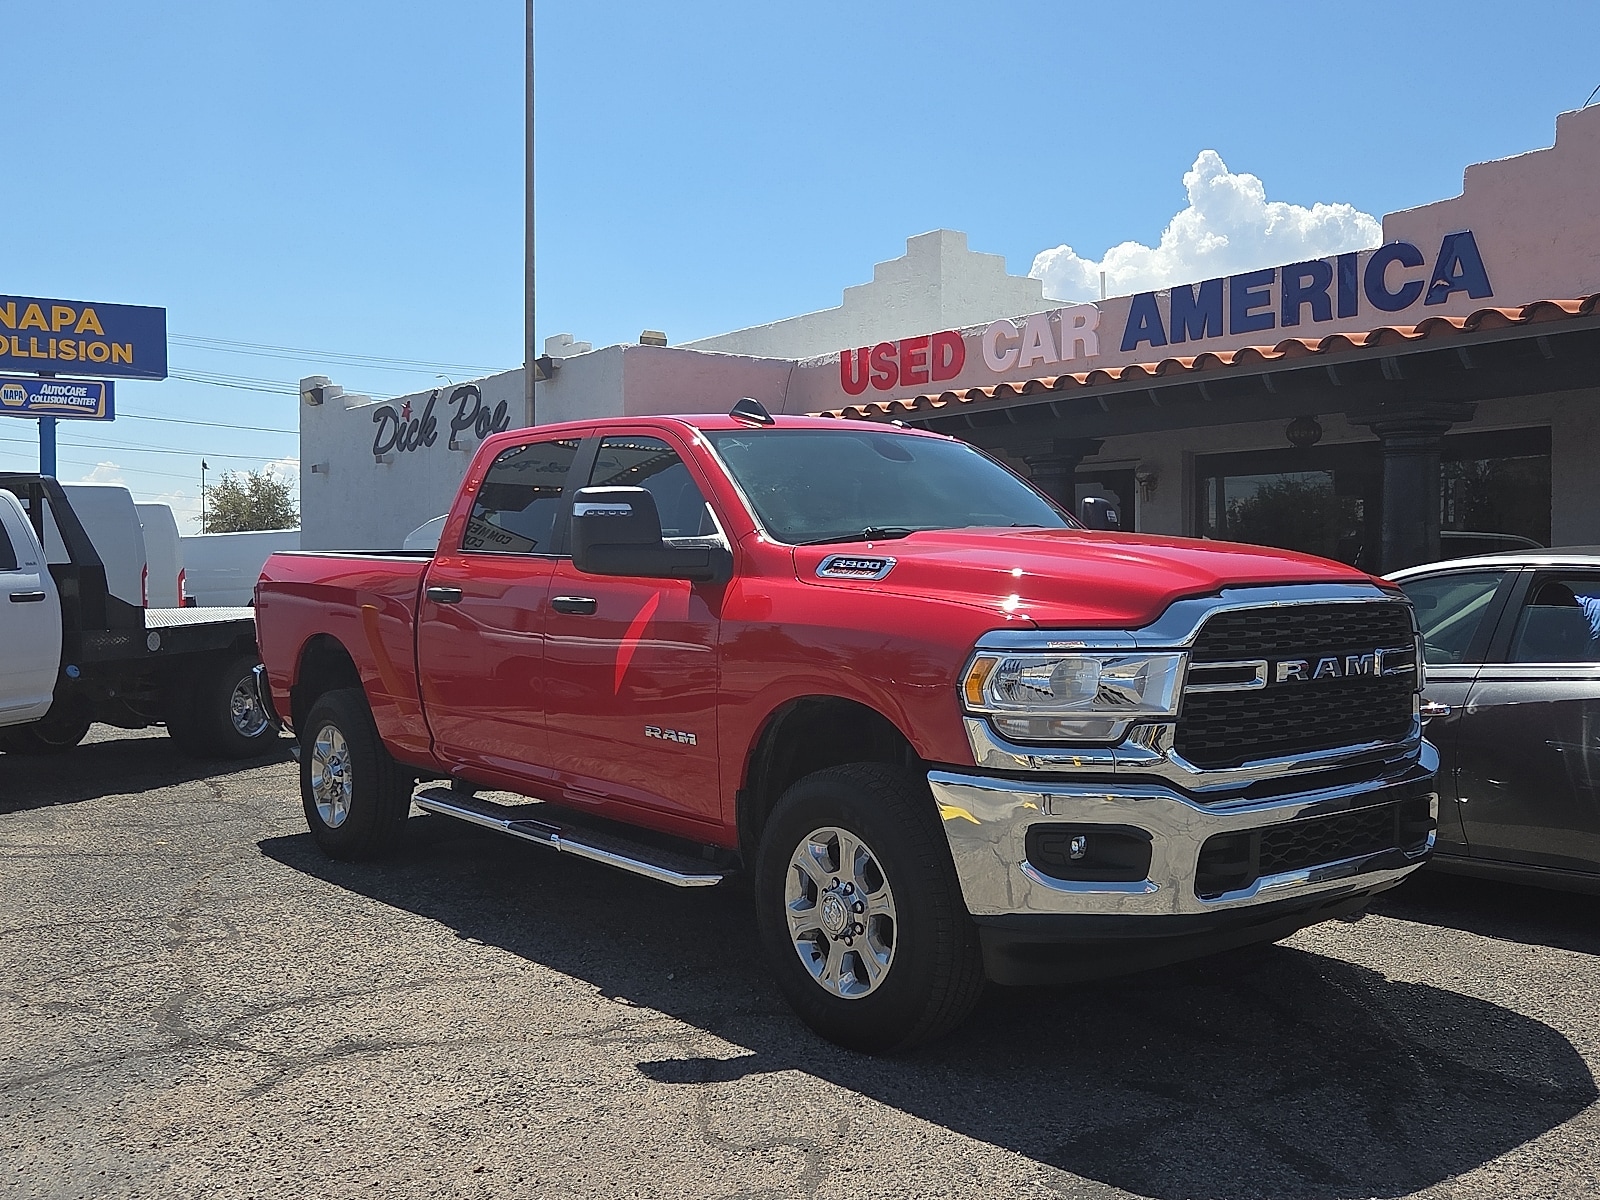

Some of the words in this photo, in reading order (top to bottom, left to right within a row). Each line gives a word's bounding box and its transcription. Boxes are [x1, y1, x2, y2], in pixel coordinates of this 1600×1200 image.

[0, 301, 105, 336] NAPA
[839, 329, 966, 396] USED
[981, 302, 1102, 373] CAR
[1119, 229, 1495, 352] AMERICA
[3, 389, 24, 401] NAPA
[29, 393, 68, 405] COLLISION
[67, 396, 97, 406] CENTER
[372, 389, 438, 456] Dick
[448, 384, 510, 450] Poe
[832, 559, 881, 570] 2500
[1275, 653, 1375, 683] RAM
[645, 725, 697, 746] RAM
